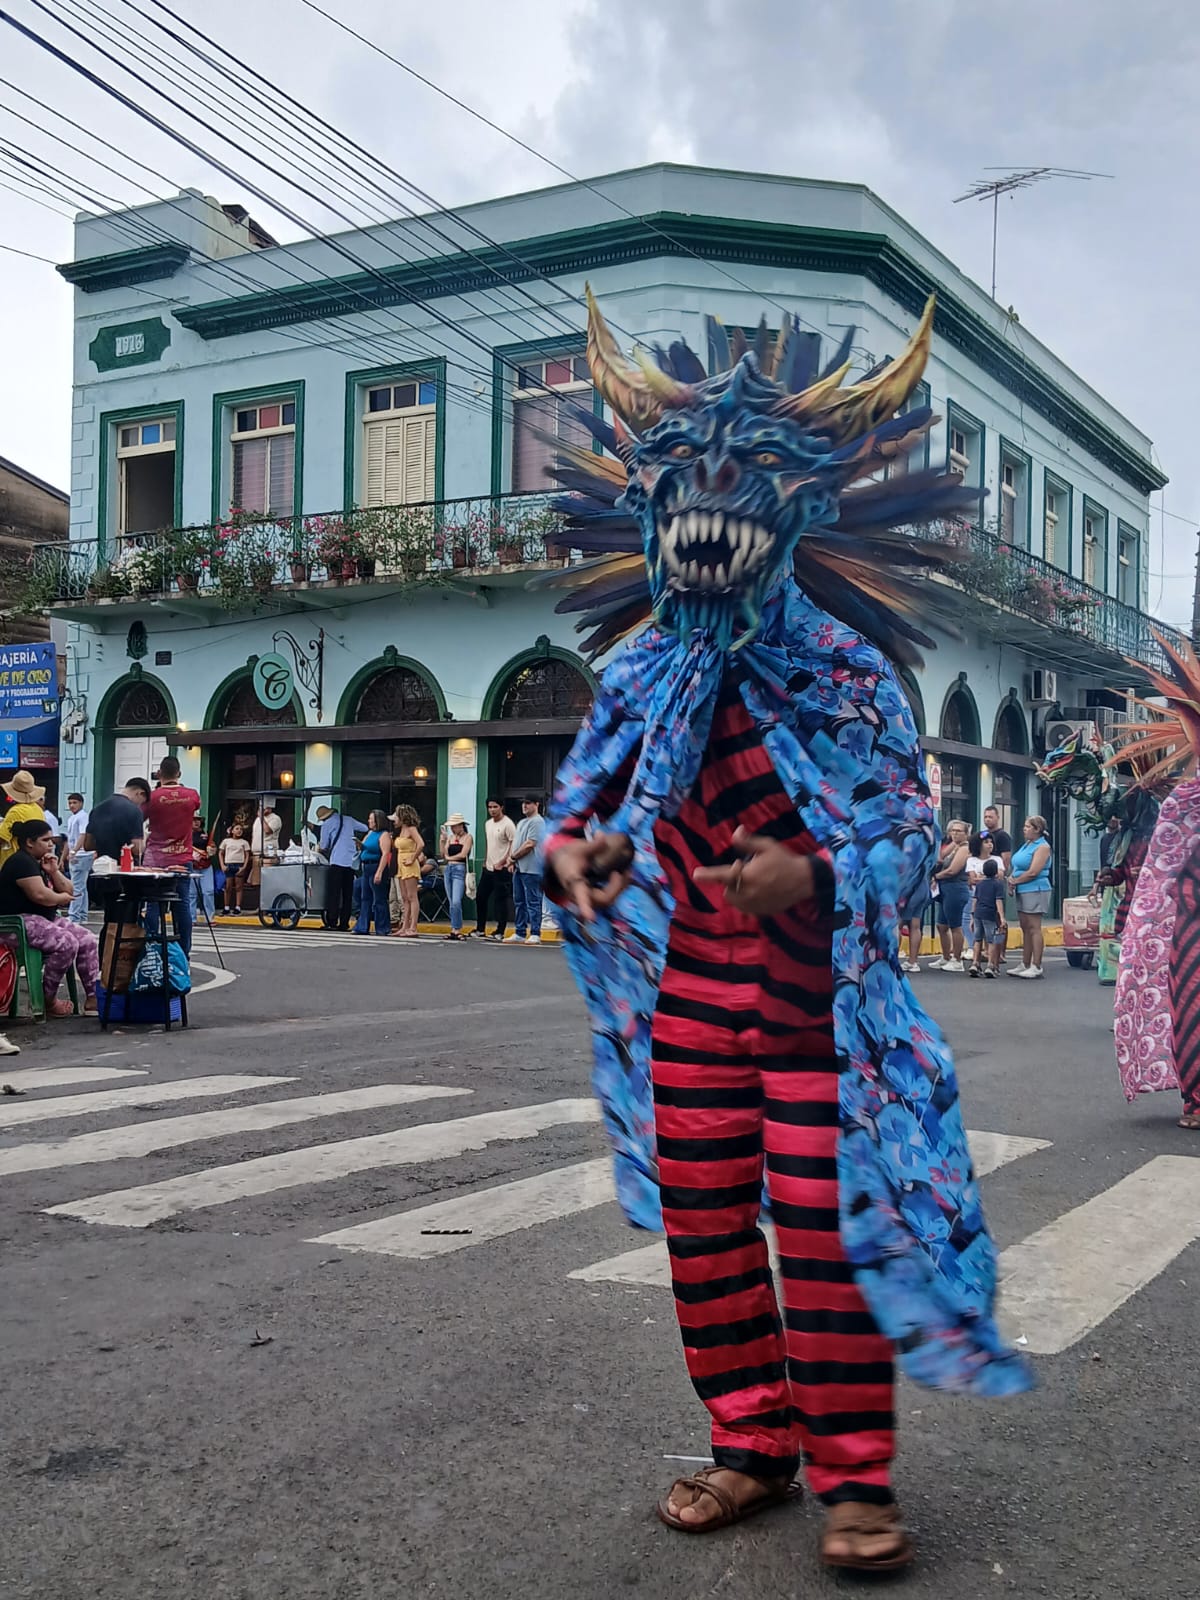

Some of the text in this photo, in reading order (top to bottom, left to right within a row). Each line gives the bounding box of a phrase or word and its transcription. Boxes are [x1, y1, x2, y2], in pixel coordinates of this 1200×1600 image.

[12, 671, 25, 685] DE
[27, 669, 51, 684] ORO
[260, 662, 289, 700] C
